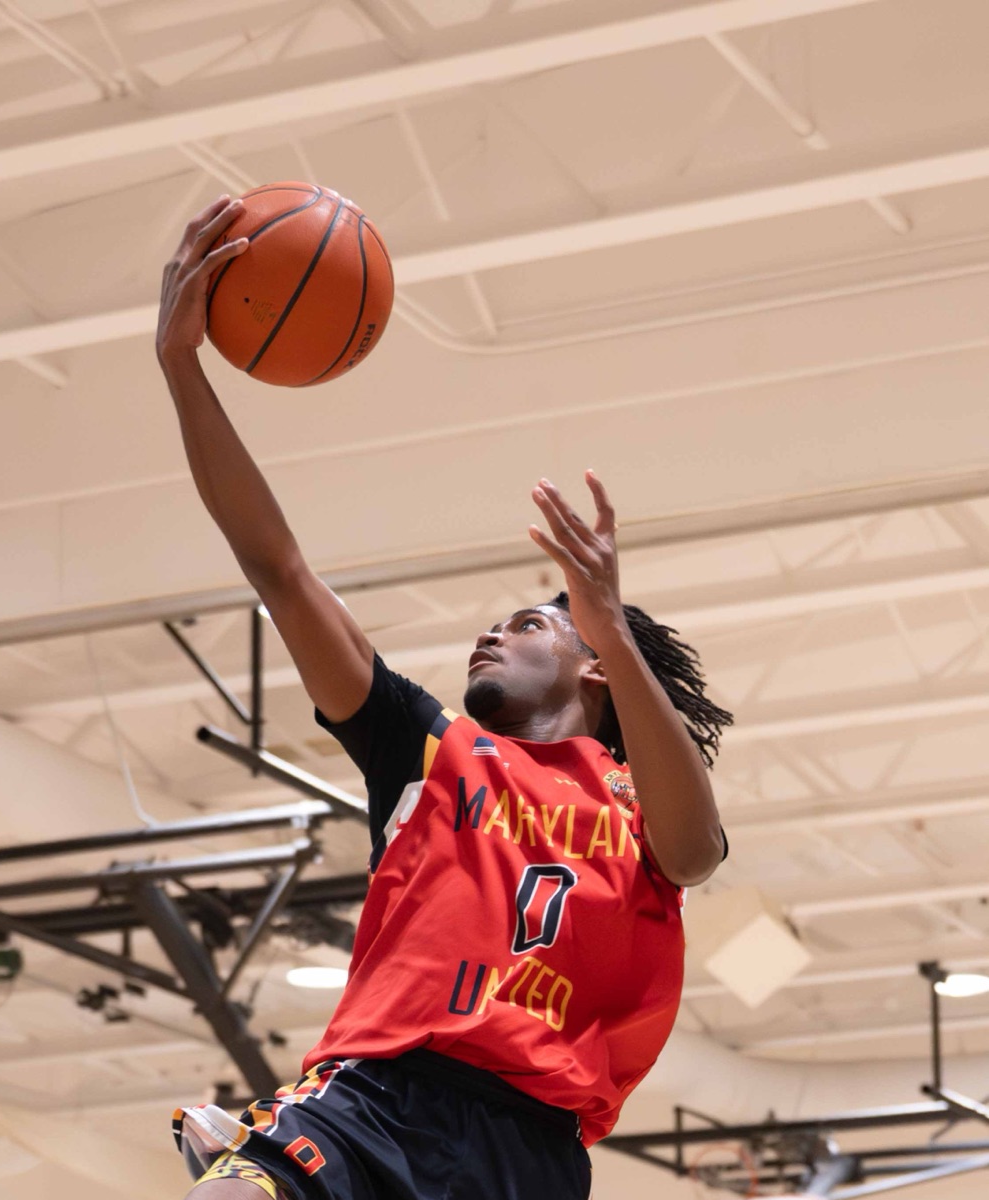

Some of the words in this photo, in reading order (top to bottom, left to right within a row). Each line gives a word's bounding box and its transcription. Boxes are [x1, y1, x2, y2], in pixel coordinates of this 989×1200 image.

[454, 776, 641, 862] MARYLAN
[511, 863, 578, 955] 0
[448, 955, 573, 1032] UNTED
